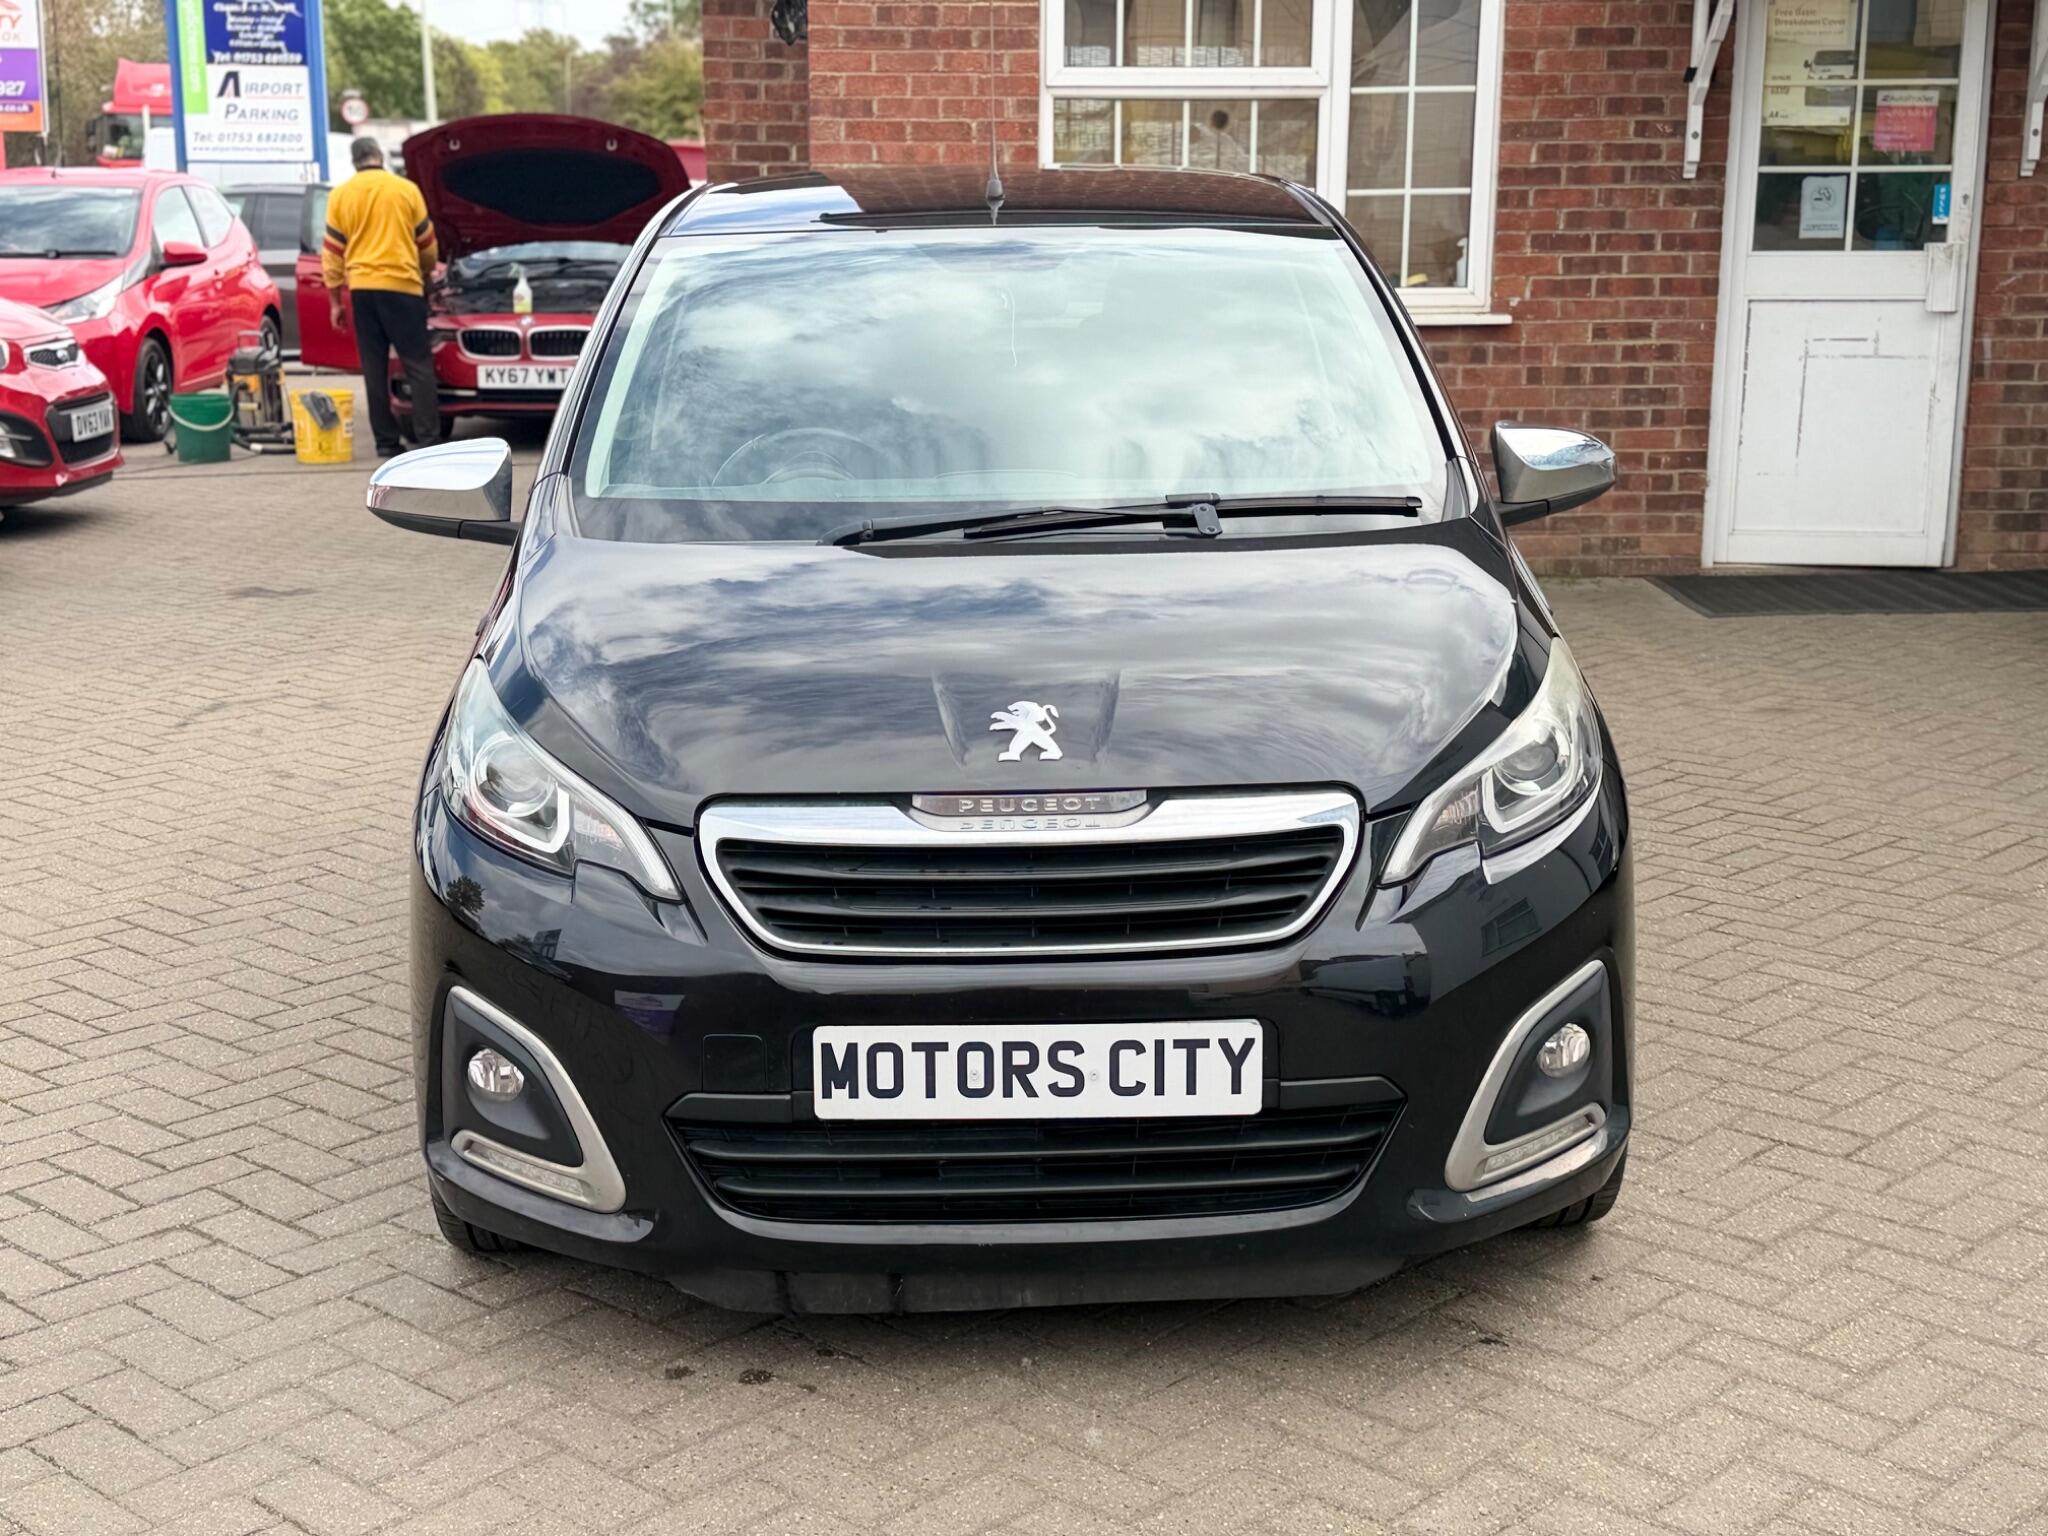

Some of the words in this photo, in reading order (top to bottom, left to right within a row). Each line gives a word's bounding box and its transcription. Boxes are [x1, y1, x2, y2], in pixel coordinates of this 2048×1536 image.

[217, 71, 304, 98] AIRPORT
[225, 103, 300, 121] PARKING
[217, 132, 254, 143] 01753
[485, 367, 531, 384] KY67
[535, 367, 569, 383] YWT
[958, 797, 1101, 813] PEUGEOT
[821, 1040, 1086, 1100] MOTORS
[1109, 1038, 1256, 1097] CITY
